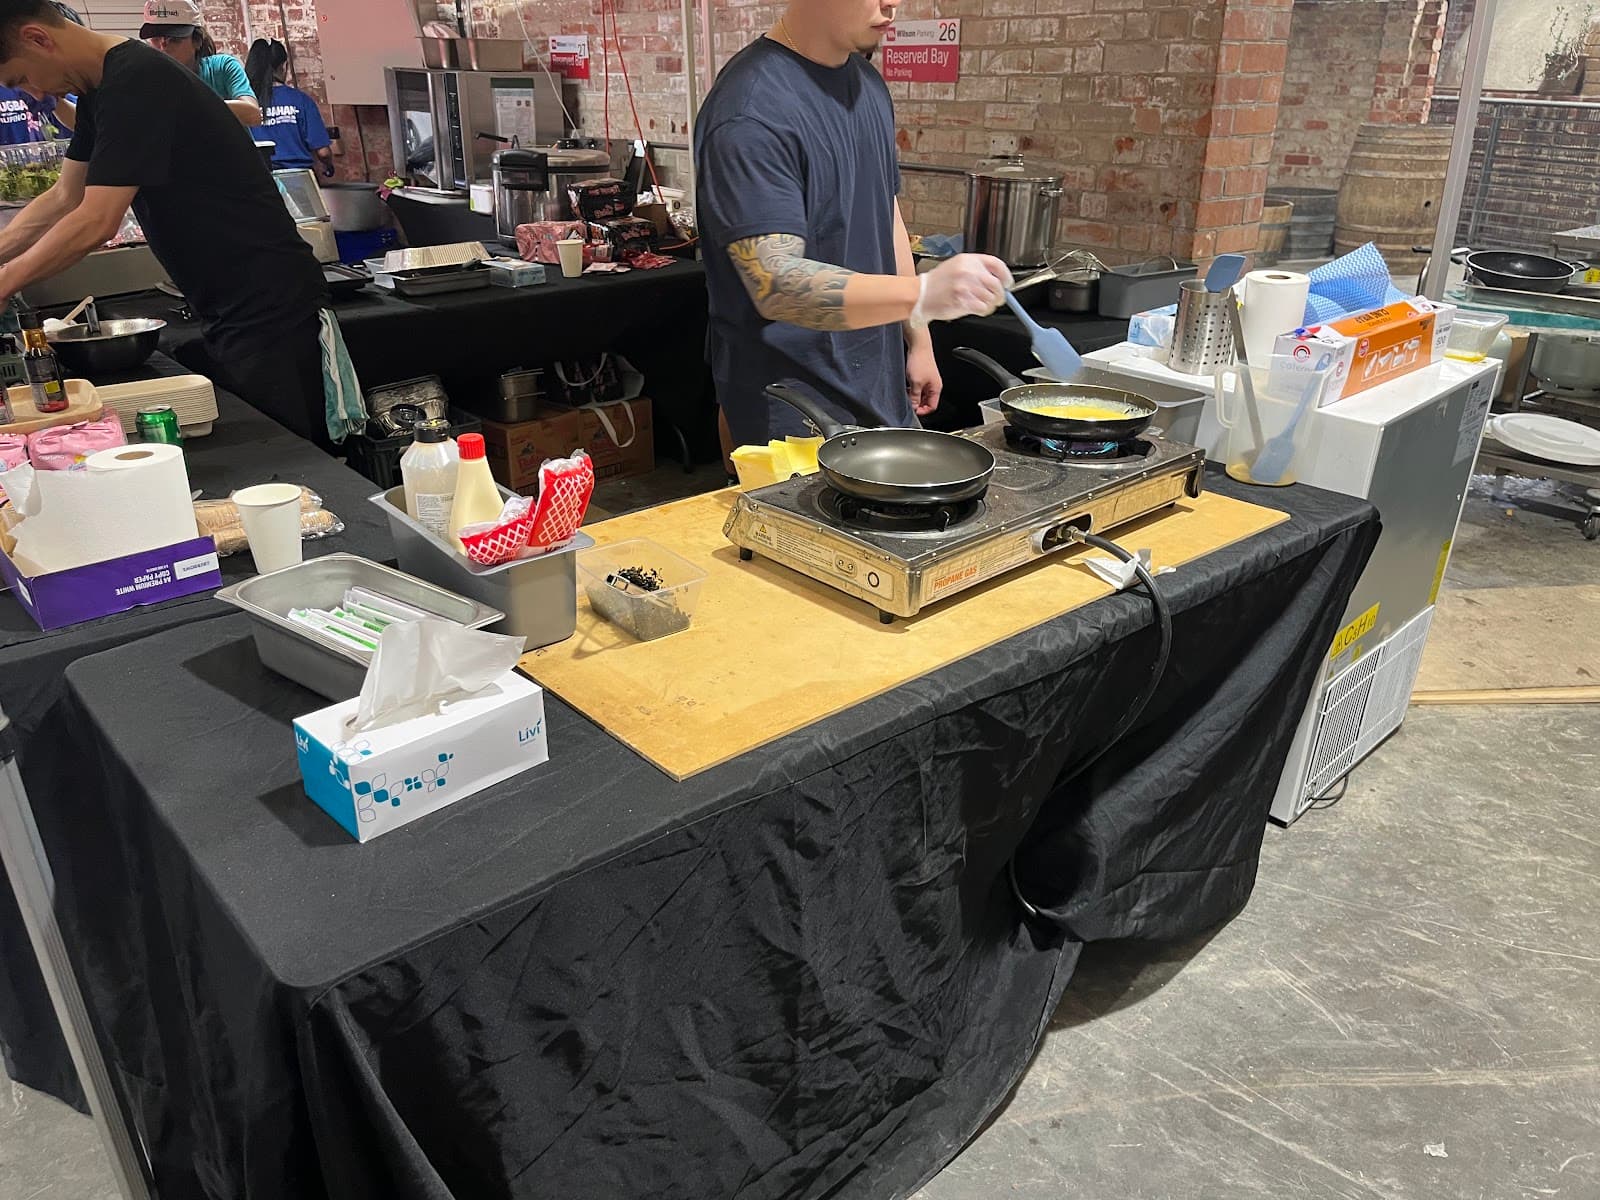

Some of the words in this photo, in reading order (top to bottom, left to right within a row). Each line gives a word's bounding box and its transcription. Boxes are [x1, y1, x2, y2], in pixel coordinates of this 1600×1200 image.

[897, 30, 916, 38] Wilson
[939, 22, 957, 41] 26
[577, 43, 586, 57] 27
[886, 48, 928, 65] Reserved
[930, 48, 950, 66] Bay
[894, 68, 913, 78] Parking
[133, 573, 154, 584] PAPER
[154, 569, 171, 579] COPY
[163, 576, 172, 584] A4
[934, 571, 964, 591] PROPANE
[964, 566, 978, 579] GAS
[115, 585, 136, 596] WHITE
[135, 577, 160, 592] PREMIUM
[518, 717, 542, 743] Livi
